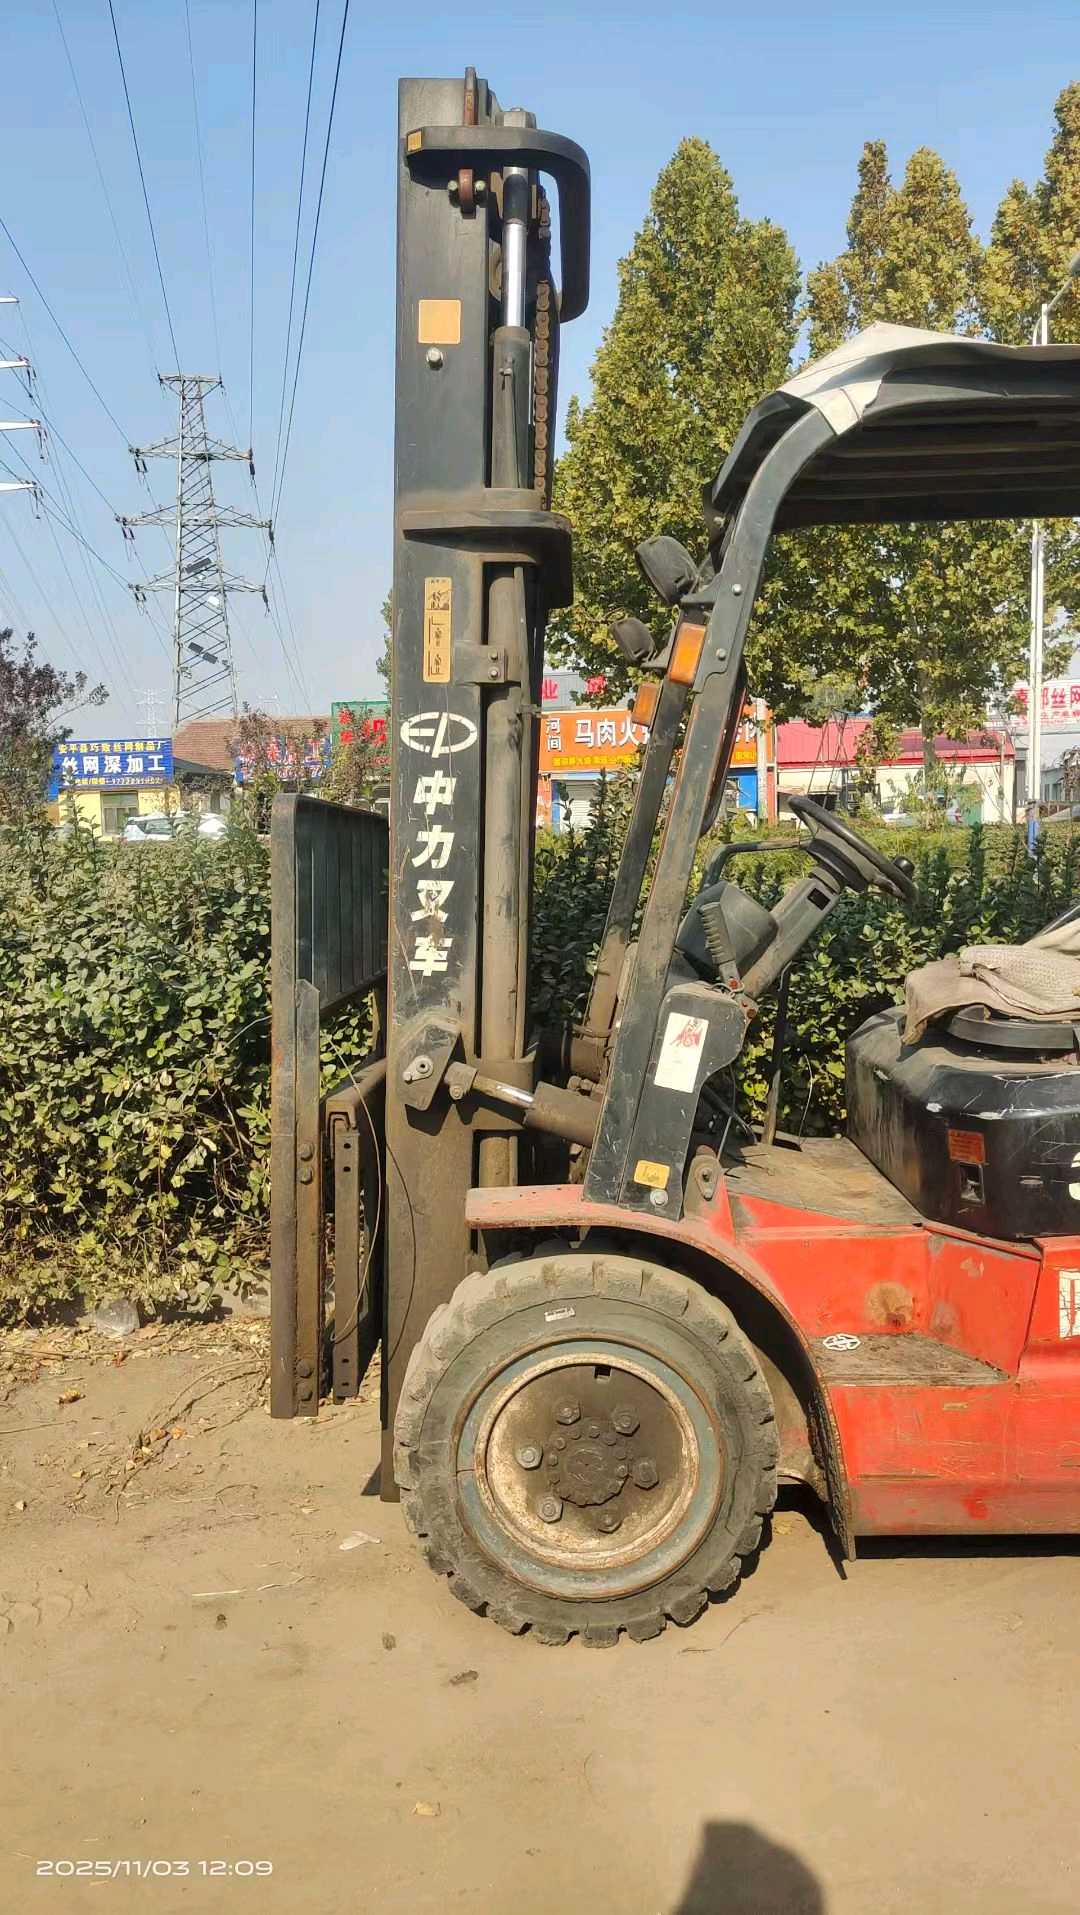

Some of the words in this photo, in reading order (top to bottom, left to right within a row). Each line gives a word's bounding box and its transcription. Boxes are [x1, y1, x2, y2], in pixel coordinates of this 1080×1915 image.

[545, 718, 562, 751] 河间
[62, 755, 166, 775] 丝网深加工
[409, 770, 456, 977] 中力叉车
